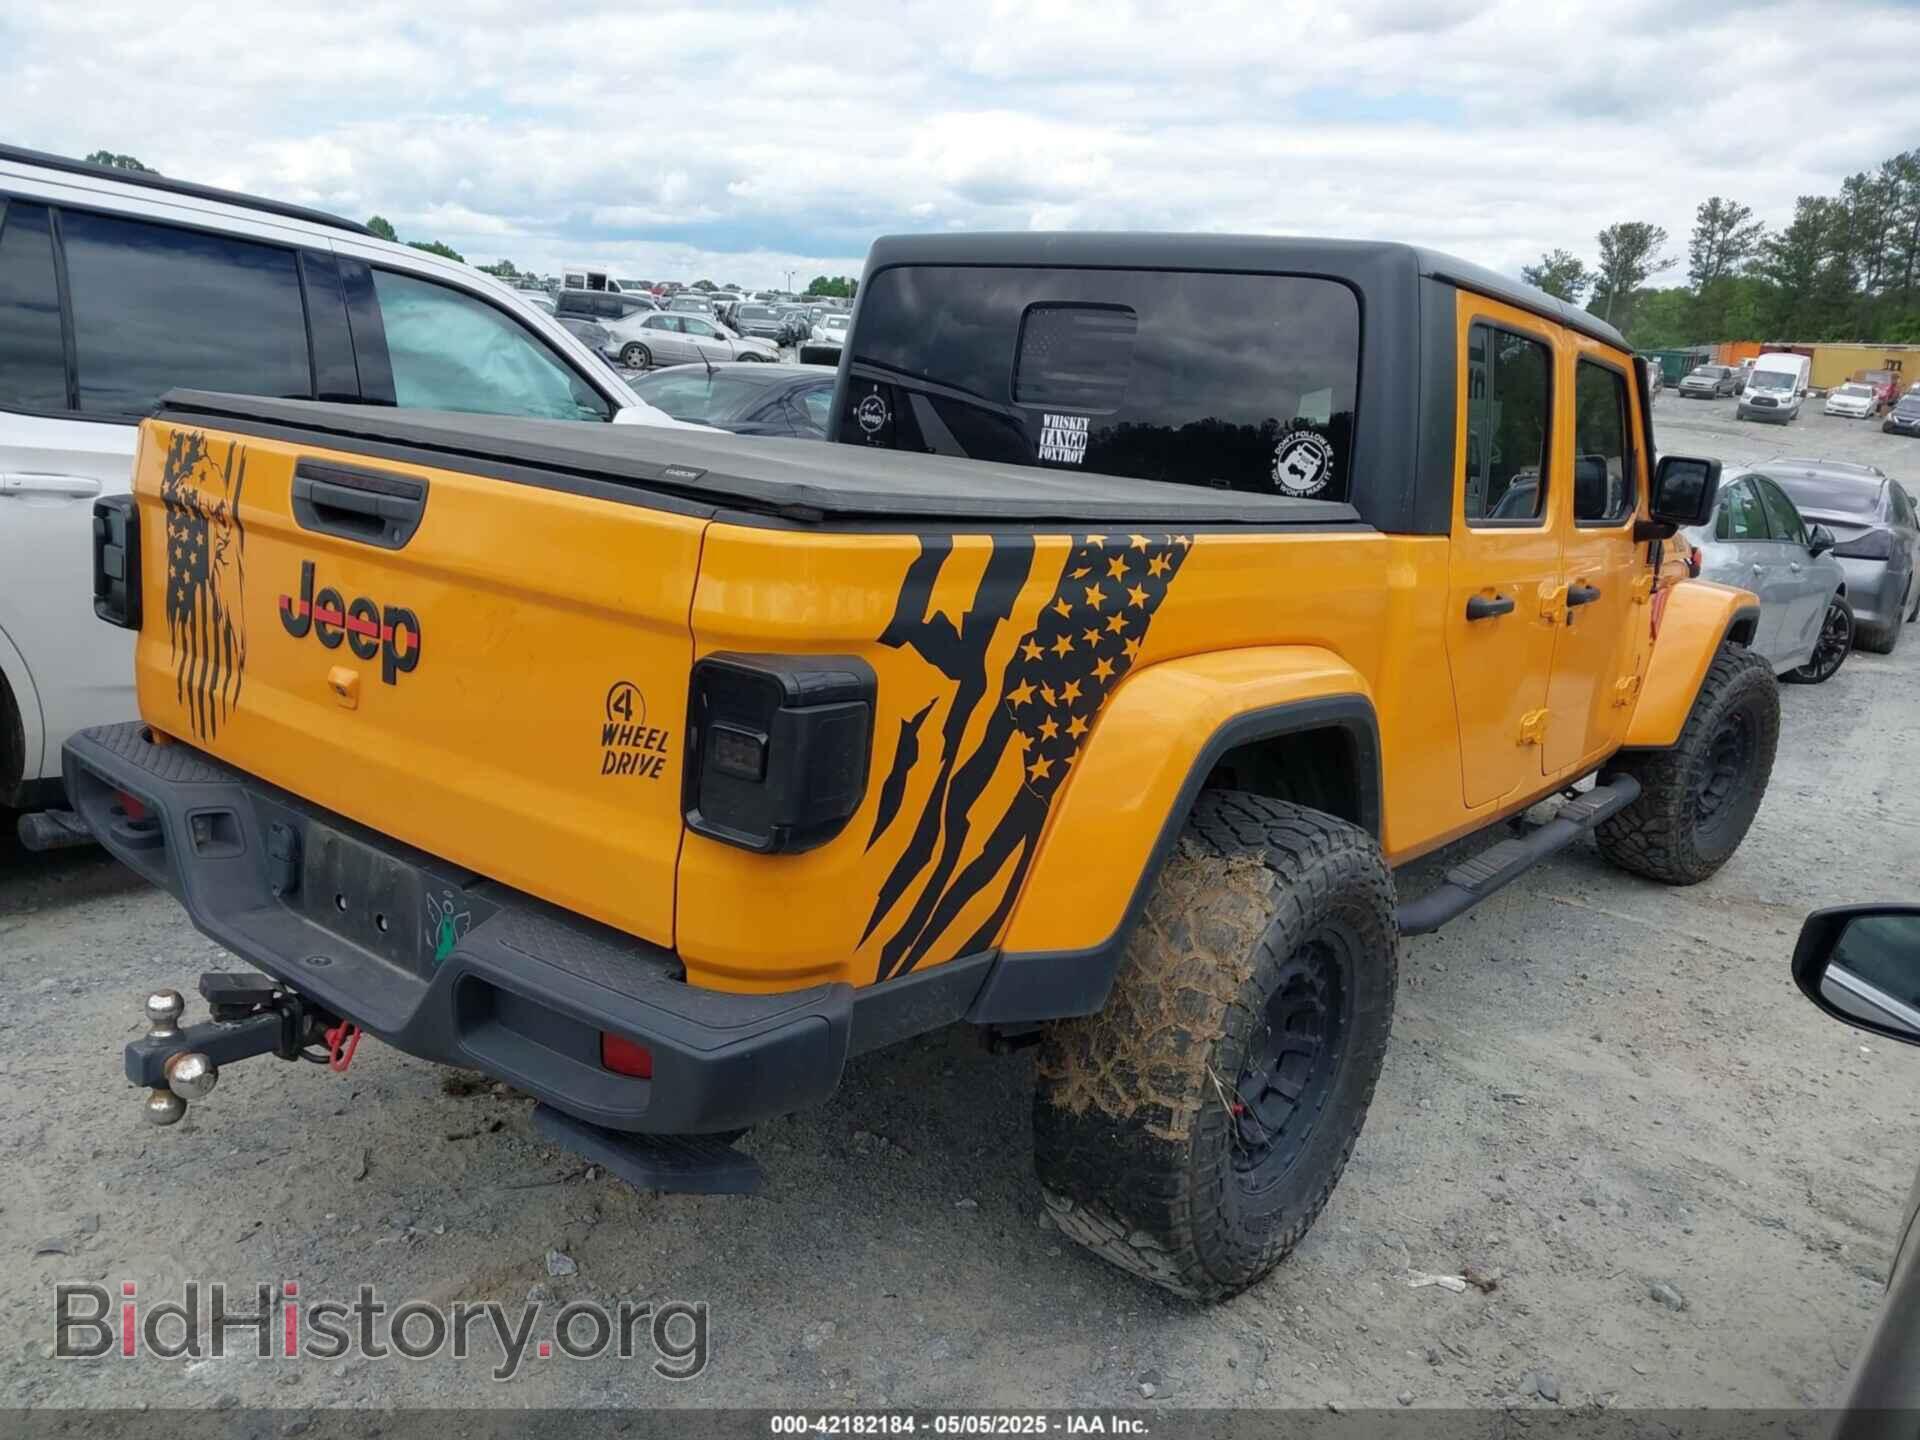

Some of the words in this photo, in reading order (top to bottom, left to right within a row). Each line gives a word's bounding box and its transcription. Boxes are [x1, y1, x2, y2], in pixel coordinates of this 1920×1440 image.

[1043, 413, 1090, 431] WHISKEY
[1040, 427, 1088, 450] TANGO
[1295, 430, 1328, 446] FOLLOW
[1324, 444, 1334, 458] ME
[1038, 446, 1086, 464] FOXTROT
[1271, 468, 1282, 485] YOU
[1306, 480, 1328, 497] MAKE
[278, 559, 421, 686] Jeep
[601, 723, 669, 753] WHEEL
[601, 750, 667, 779] DRIVE
